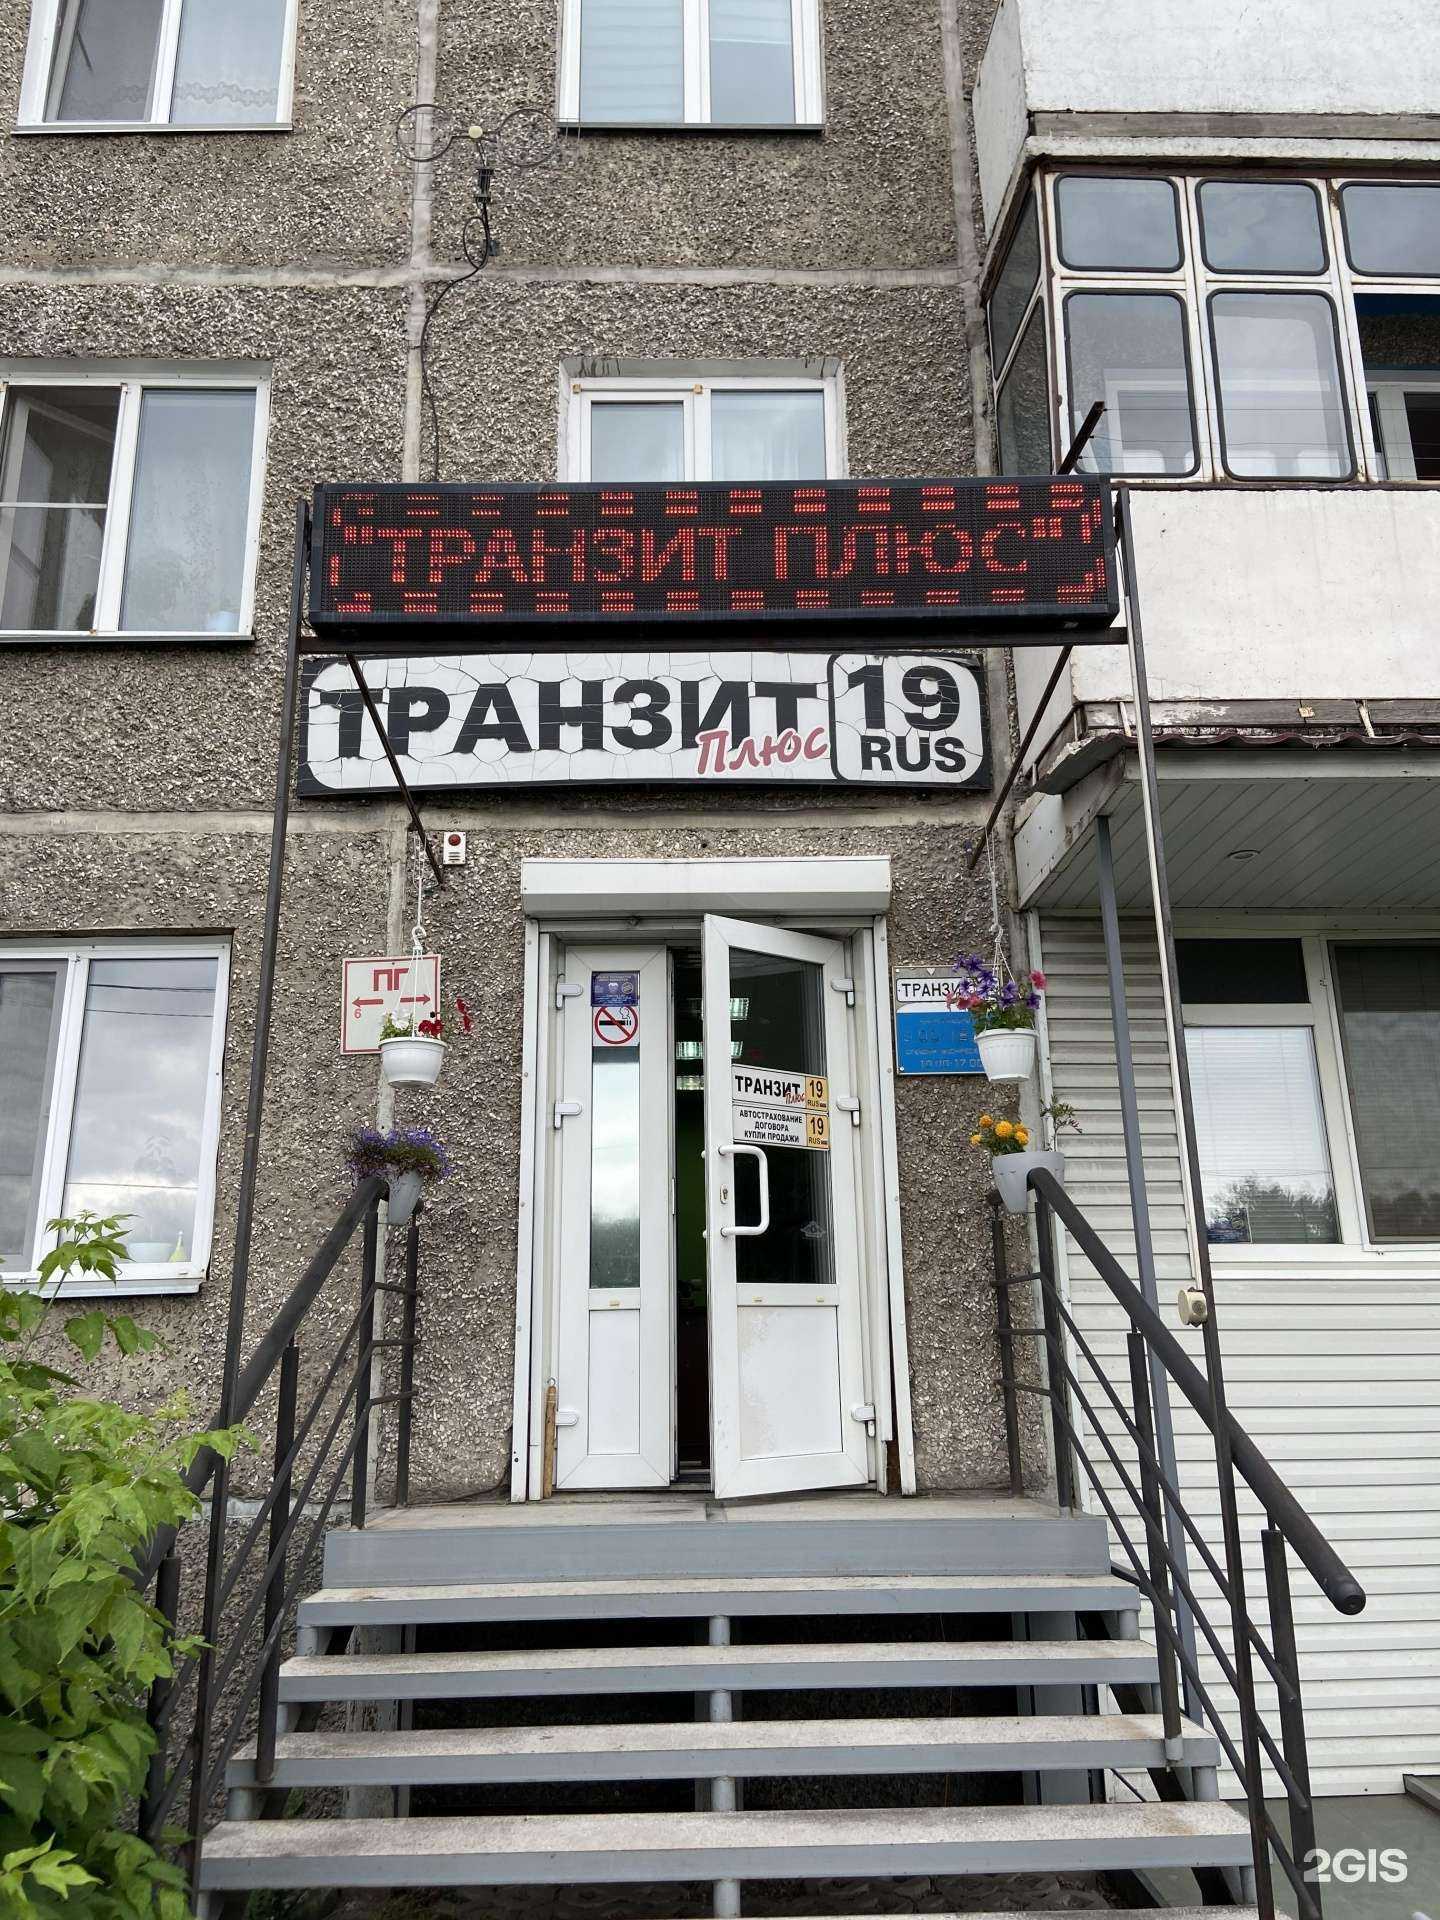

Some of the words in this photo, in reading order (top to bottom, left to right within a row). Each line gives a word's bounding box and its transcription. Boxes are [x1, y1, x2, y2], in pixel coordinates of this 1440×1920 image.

[847, 665, 961, 732] 19
[319, 679, 818, 758] ТРАНЗИТ
[860, 735, 967, 774] RUS
[373, 967, 410, 992] ПГ
[734, 1075, 801, 1098] ТРАНЗИТ
[809, 1079, 824, 1099] 19
[807, 1099, 819, 1107] RUS
[739, 1109, 803, 1124] АВТОСТРАХОВАНИЕ
[810, 1116, 824, 1135] 19
[754, 1121, 790, 1132] ДОГОВОРА
[744, 1130, 766, 1140] КУПЛИ
[767, 1132, 800, 1144] ПРОДАЖИ
[808, 1136, 820, 1145] RUS
